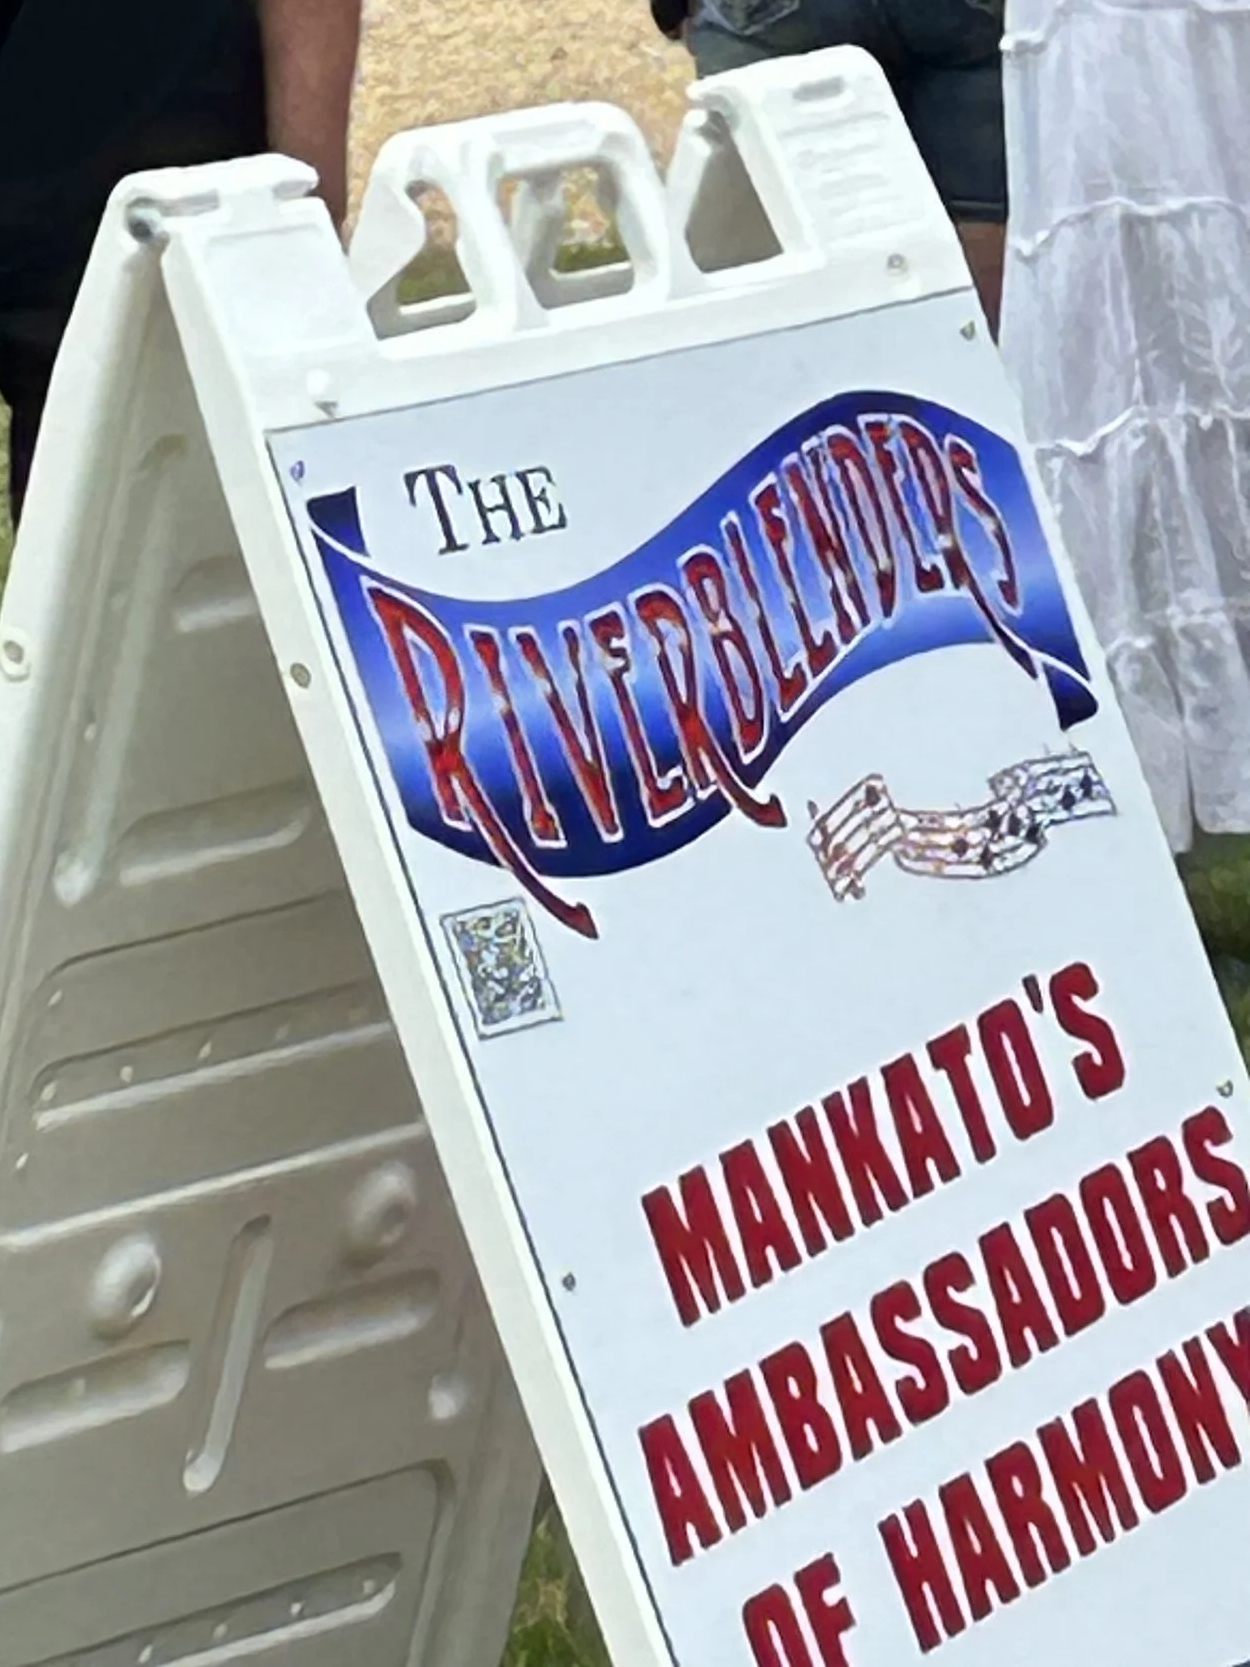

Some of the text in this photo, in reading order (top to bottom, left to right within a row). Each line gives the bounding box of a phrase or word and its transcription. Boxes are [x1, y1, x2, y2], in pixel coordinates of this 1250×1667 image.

[362, 414, 1037, 939] RIVERBLENDERS
[404, 464, 568, 555] THE
[640, 961, 1126, 1327] MANKATO'S
[638, 1106, 1250, 1566] AMBASSADORS
[741, 1553, 856, 1667] OF
